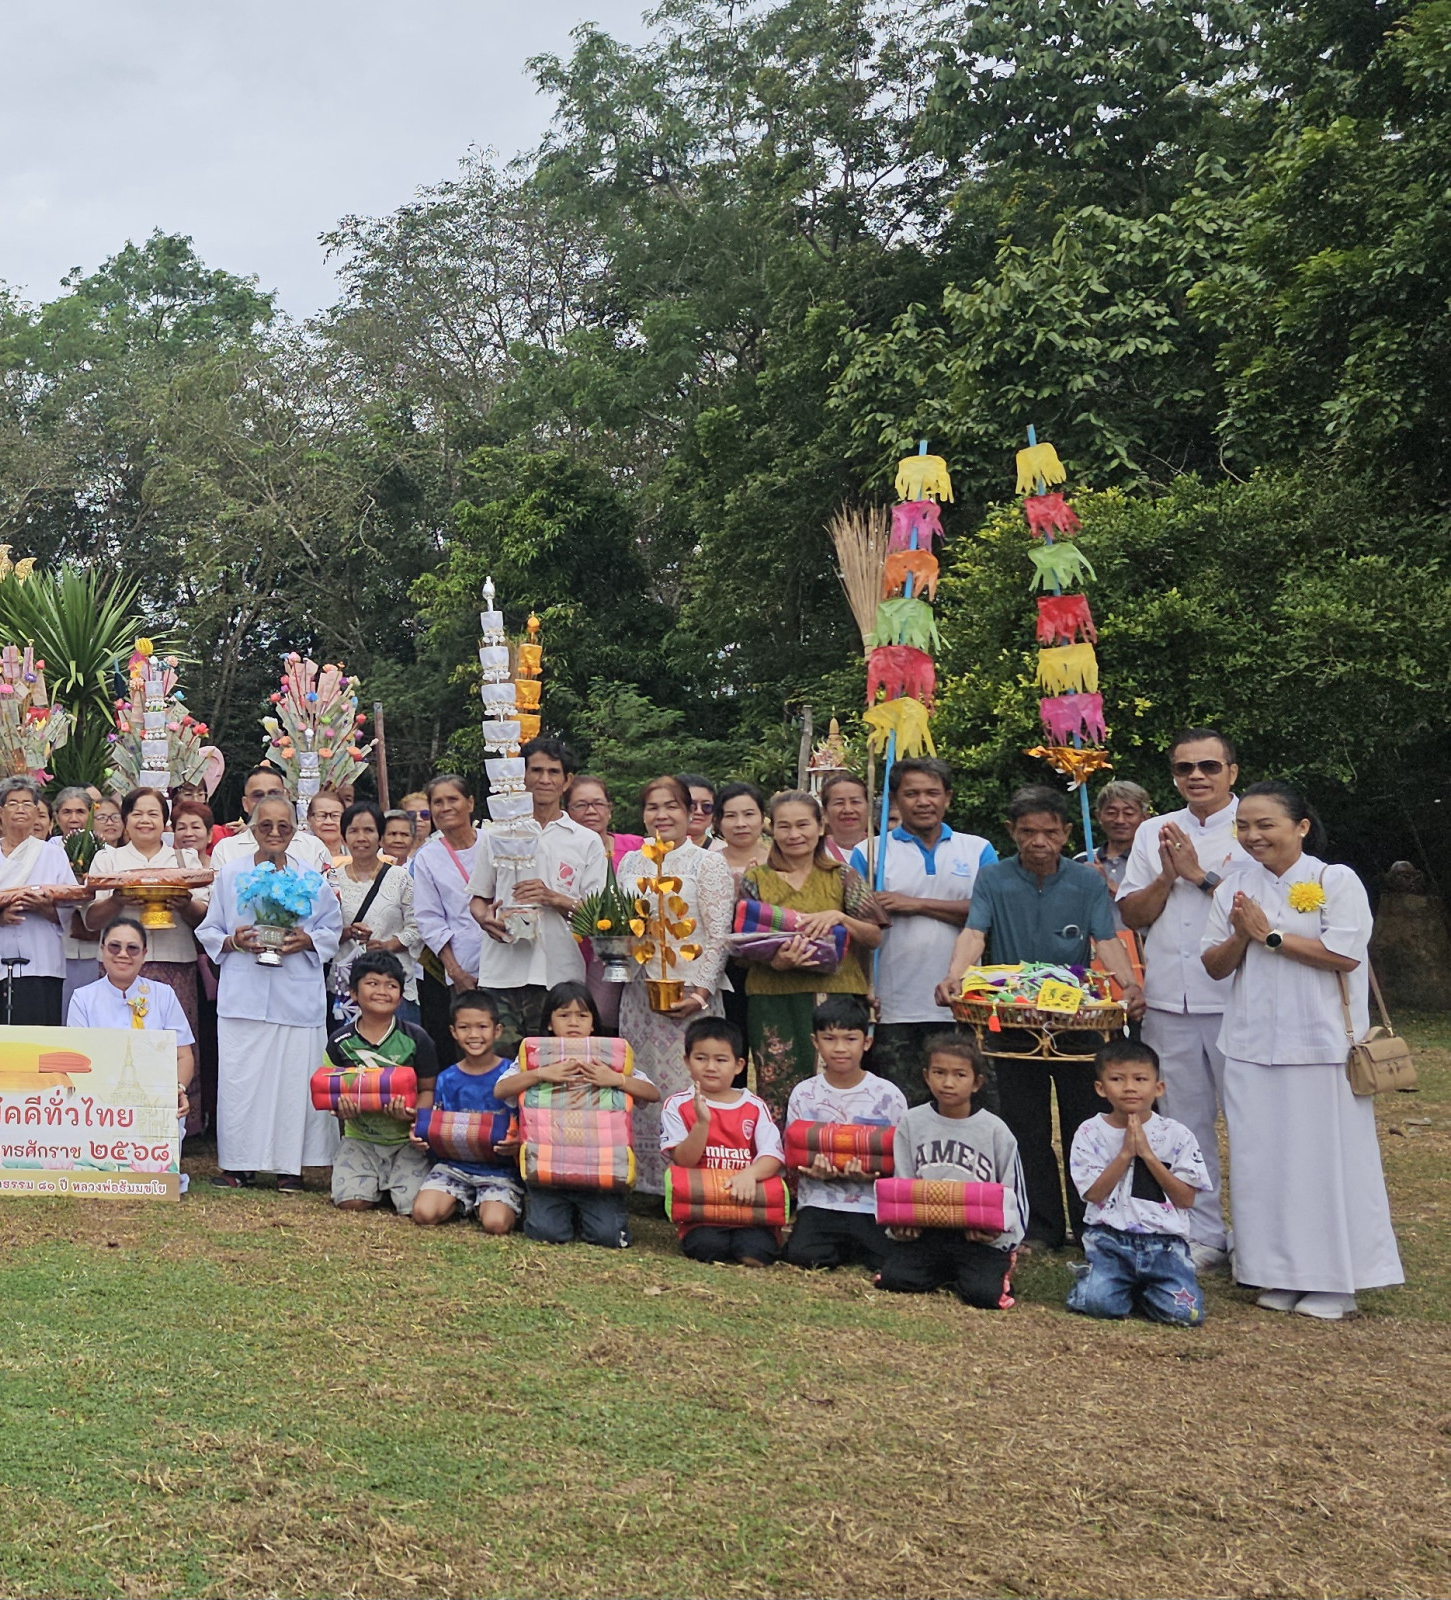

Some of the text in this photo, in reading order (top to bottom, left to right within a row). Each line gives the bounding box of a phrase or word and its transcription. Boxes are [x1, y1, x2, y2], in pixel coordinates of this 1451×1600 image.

[89, 1140, 170, 1161] ๒๕๖๘
[705, 1145, 752, 1160] mirate
[706, 1158, 720, 1169] FLY
[915, 1139, 993, 1182] AMES
[59, 1177, 68, 1191] ปี
